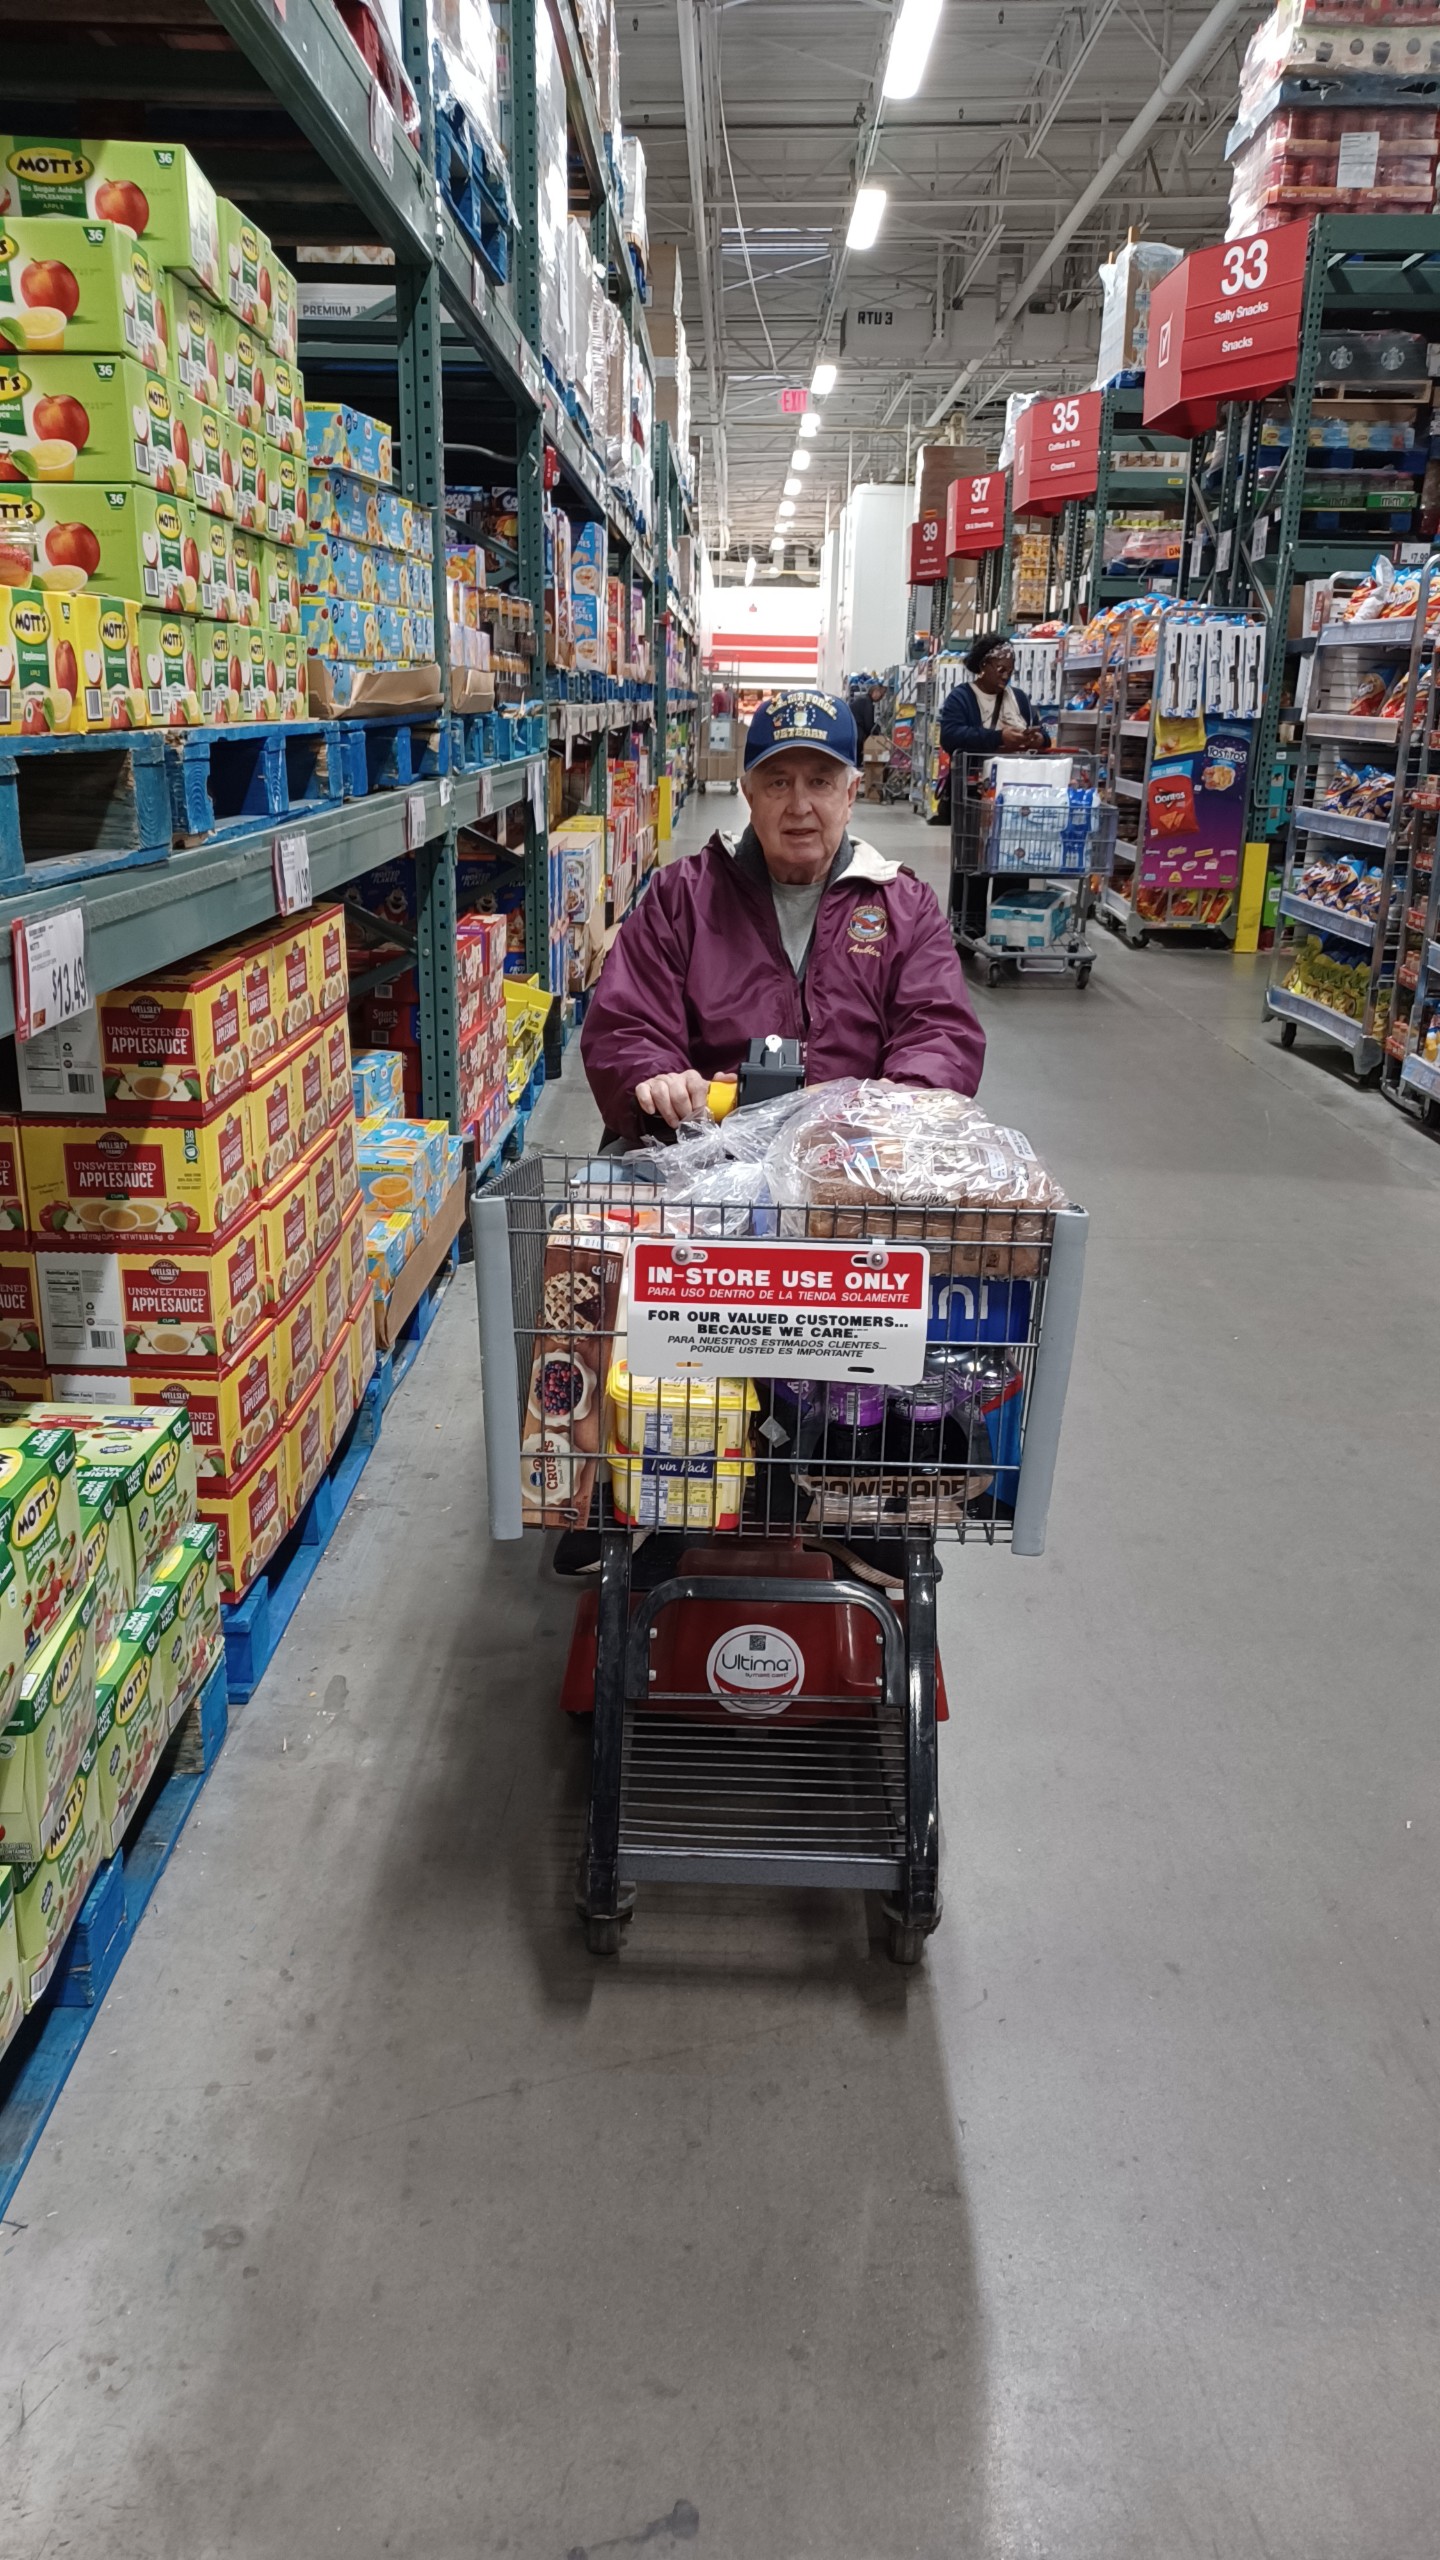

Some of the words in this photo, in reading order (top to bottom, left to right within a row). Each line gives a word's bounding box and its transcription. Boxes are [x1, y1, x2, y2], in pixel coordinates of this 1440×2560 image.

[16, 156, 84, 175] MOTT'S
[158, 152, 172, 164] 36
[88, 229, 104, 241] 36
[1221, 238, 1269, 296] 33
[303, 304, 351, 316] PREMIUM
[857, 311, 882, 325] RTU
[884, 311, 893, 325] 3
[1214, 310, 1235, 325] Salty
[1236, 300, 1269, 319] Snacks
[1221, 335, 1253, 353] Snacks
[98, 365, 113, 376] 36
[147, 391, 170, 411] MOTT'S
[782, 390, 808, 412] EXIT
[1052, 399, 1080, 434] 35
[110, 493, 124, 505] 36
[971, 477, 991, 503] 37
[158, 514, 181, 532] MOTT'S
[922, 521, 938, 542] 39
[15, 614, 47, 632] MOTT'S
[102, 622, 126, 639] MOTT'S
[162, 632, 183, 645] MOTT'S
[773, 727, 828, 741] VETERAN
[1155, 791, 1186, 804] Doritos
[52, 957, 86, 1017] $13.49
[130, 1005, 162, 1015] WELLSLEY
[372, 1009, 398, 1018] Snack
[378, 1016, 398, 1025] pack
[106, 1026, 189, 1037] UNSWEETENED
[112, 1037, 188, 1055] APPLESAUCE
[186, 1130, 194, 1139] 38
[73, 1161, 156, 1172] UNSWEETENED
[79, 1172, 154, 1188] APPLESAUCE
[150, 1268, 180, 1276] WELLSLEY
[647, 1266, 771, 1288] IN-STORE
[782, 1270, 833, 1289] USE
[844, 1272, 910, 1290] ONLY
[128, 1287, 206, 1297] UNSWEETENED
[647, 1287, 676, 1297] PARA
[680, 1288, 705, 1298] USO
[709, 1289, 755, 1299] DENTRO
[758, 1289, 775, 1299] DE
[778, 1290, 794, 1300] LA
[798, 1291, 837, 1301] TIENDA
[841, 1292, 910, 1303] SOLAMENTE
[132, 1298, 205, 1313] APPLESAUCE
[648, 1310, 680, 1321] FOR
[687, 1311, 720, 1323] OUR
[727, 1312, 788, 1325] VALUED
[795, 1314, 909, 1328] CUSTOMERS...
[697, 1324, 773, 1337] BECAUSE
[779, 1326, 803, 1337] WE
[810, 1327, 859, 1339] CARE.
[667, 1336, 695, 1345] PARA
[699, 1337, 757, 1346] NUESTROS
[761, 1338, 824, 1348] ESTIMADOS
[690, 1345, 734, 1355] PORQUE
[738, 1346, 774, 1355] USTED
[778, 1347, 792, 1356] ES
[796, 1348, 863, 1358] IMPORTANTE
[162, 1392, 190, 1400] WELLSLEY
[244, 1384, 267, 1417] APPLESAUCE
[126, 1462, 145, 1487] VARIETY
[149, 1447, 177, 1489] MOTT'S
[128, 1480, 141, 1497] PACK
[811, 1479, 965, 1497] POWERADE
[17, 1480, 56, 1541] MOTT'S
[87, 1527, 105, 1566] OTT'S
[182, 1564, 205, 1609] MOTT'S
[160, 1593, 178, 1620] VARIETY
[161, 1611, 175, 1629] PACK
[56, 1635, 83, 1698] MOTT'S
[722, 1653, 788, 1671] Ultima
[119, 1659, 148, 1719] MOTT'S
[51, 1783, 83, 1853] MOTT'S
